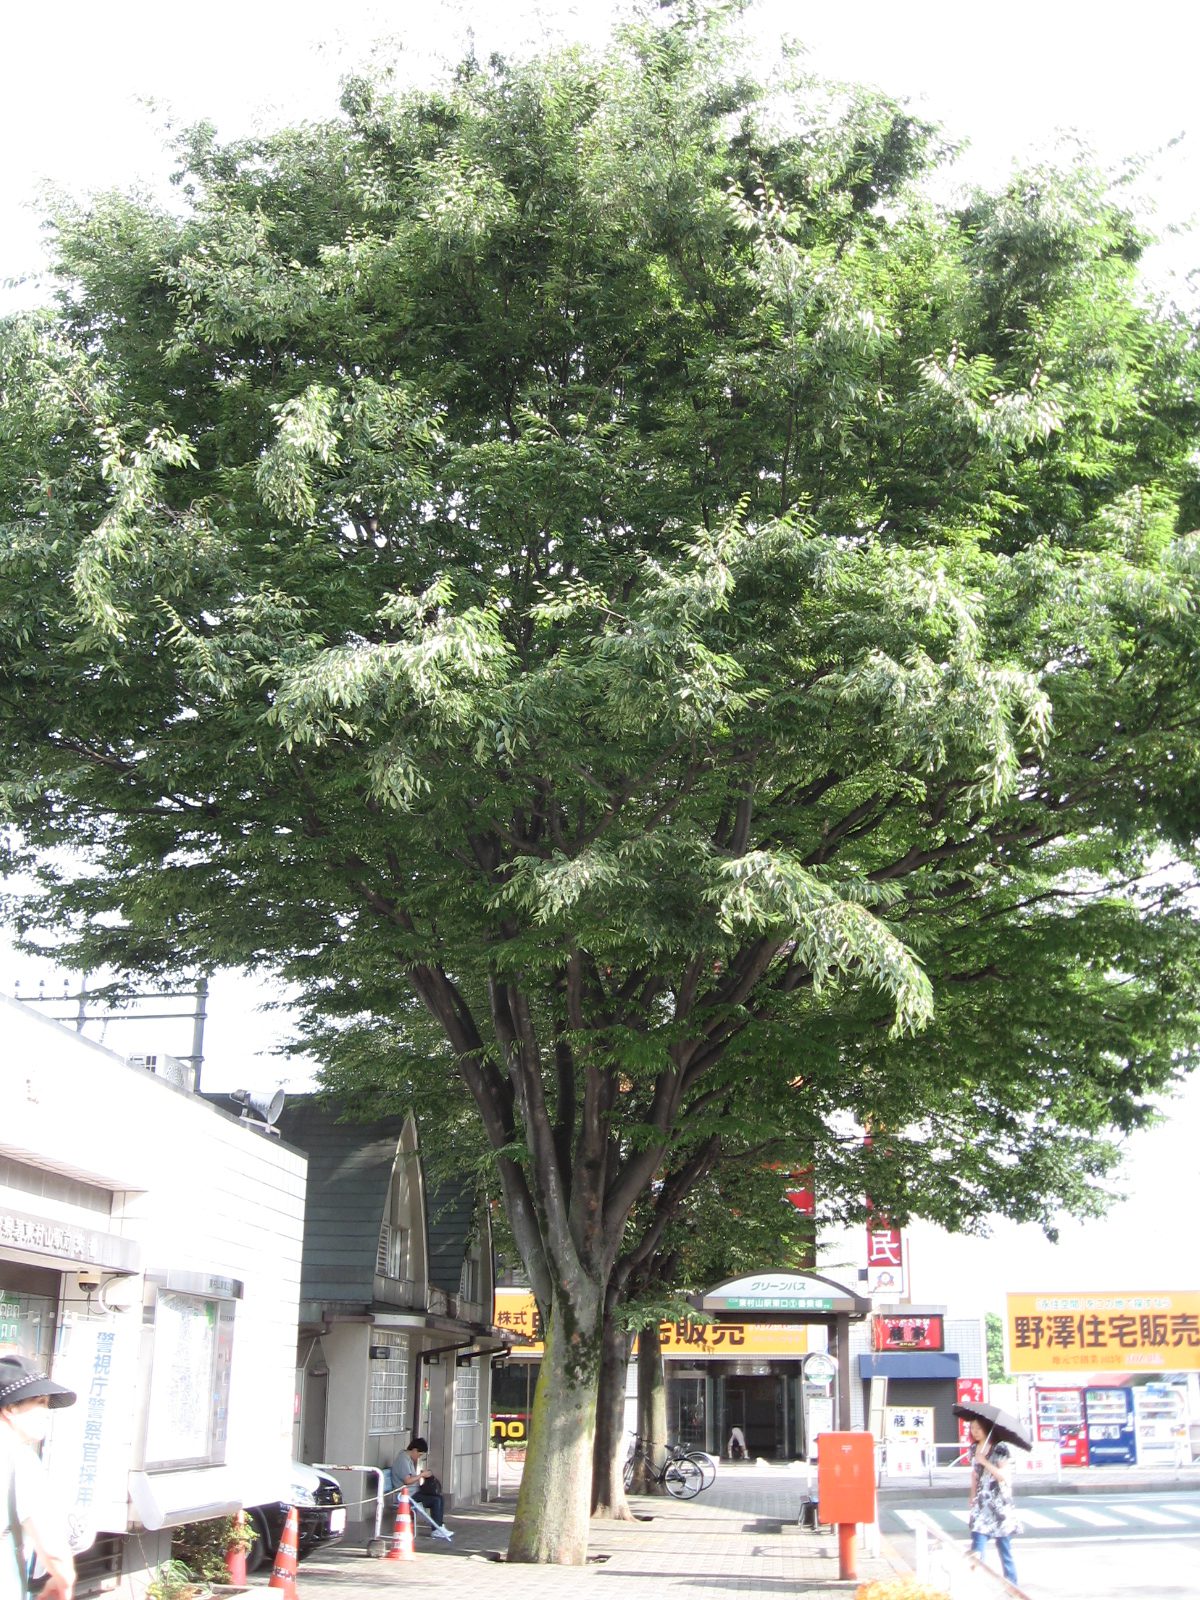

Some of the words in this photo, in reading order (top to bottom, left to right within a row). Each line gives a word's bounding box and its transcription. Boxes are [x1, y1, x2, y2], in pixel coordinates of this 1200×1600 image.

[870, 1230, 900, 1264] 民
[751, 1281, 806, 1291] グリーンバス
[1014, 1312, 1200, 1349] 野澤住宅販売
[75, 1331, 116, 1508] 警視庁警察官採用
